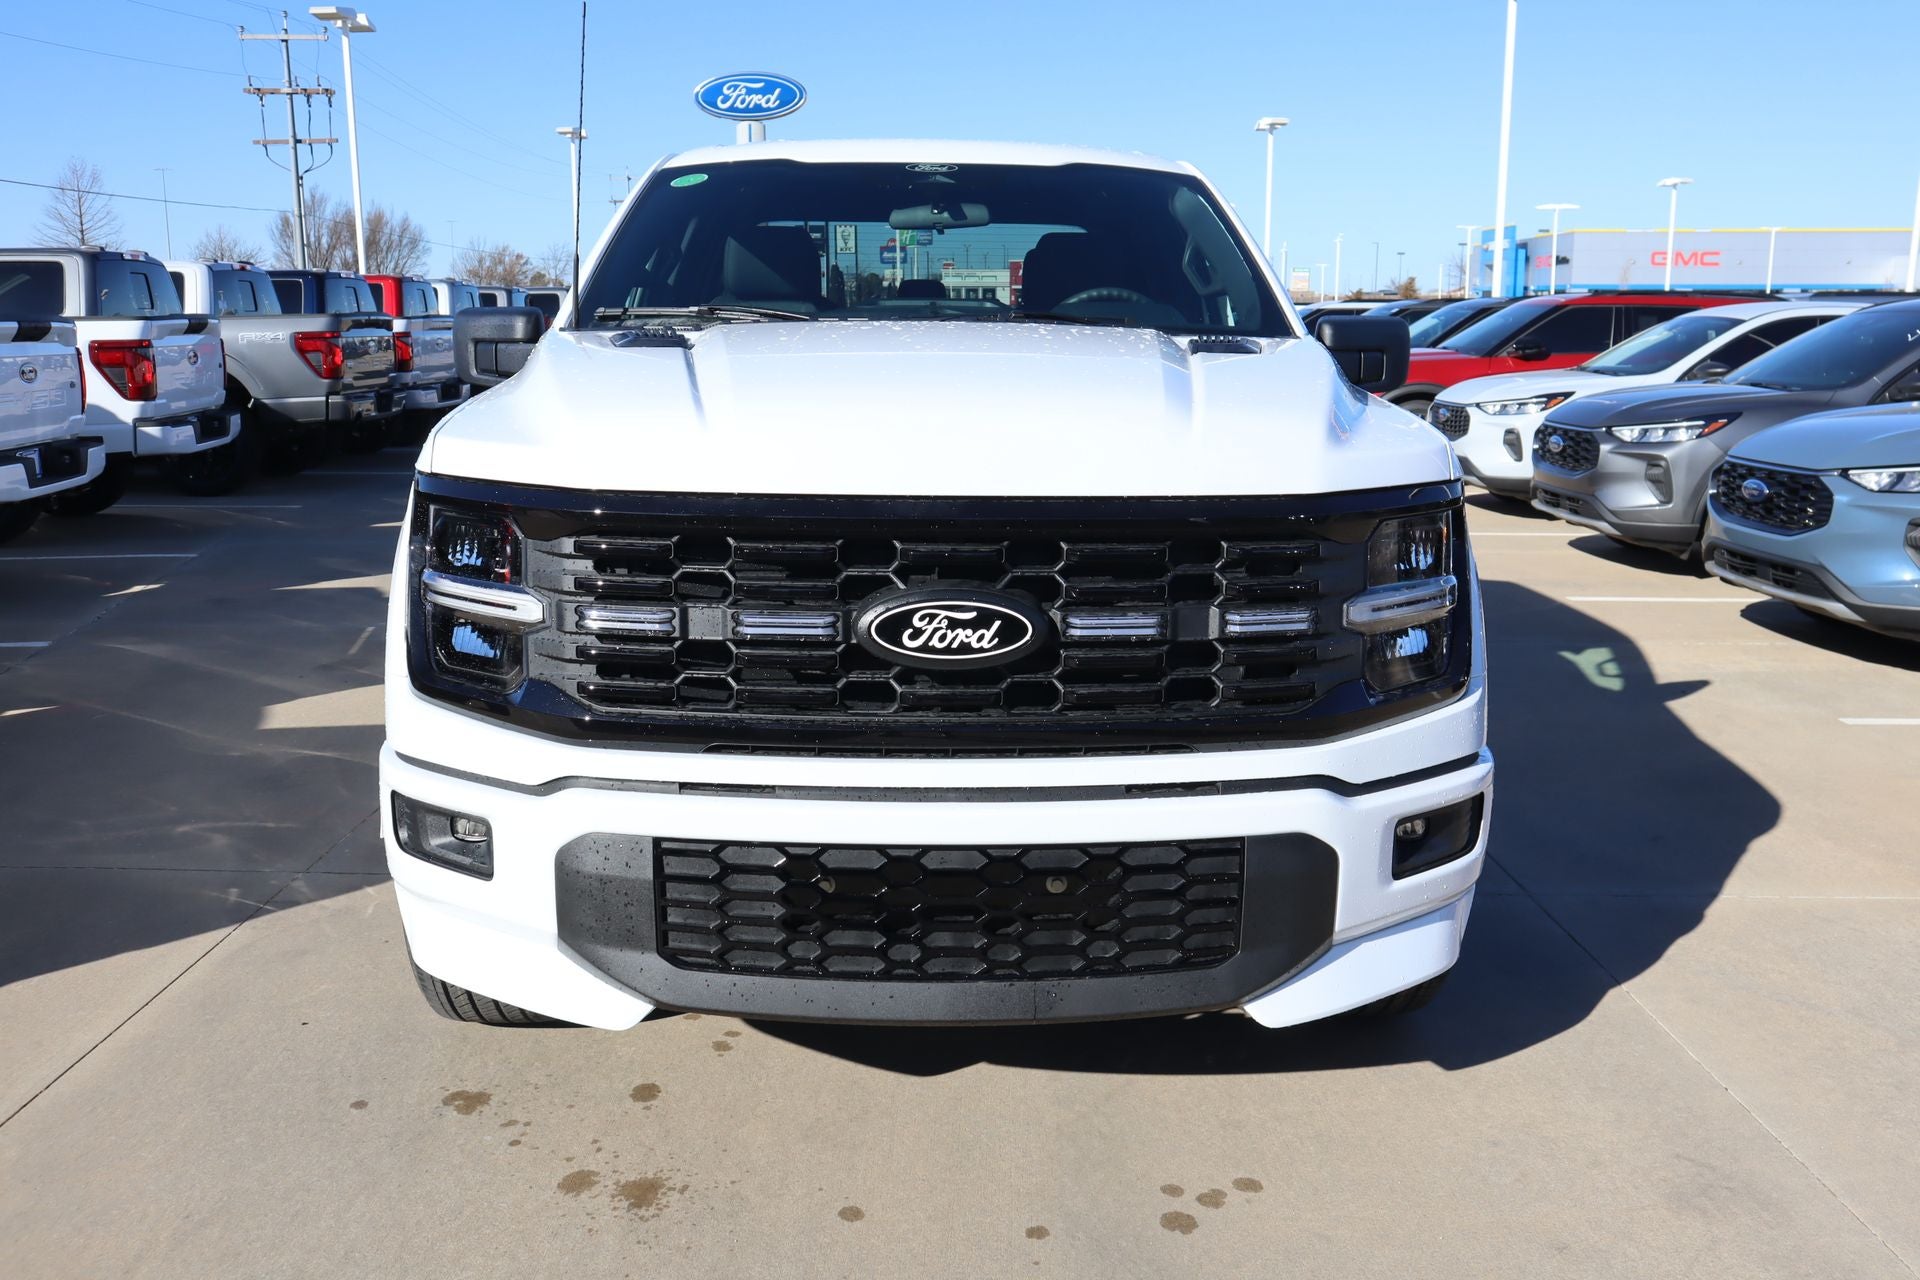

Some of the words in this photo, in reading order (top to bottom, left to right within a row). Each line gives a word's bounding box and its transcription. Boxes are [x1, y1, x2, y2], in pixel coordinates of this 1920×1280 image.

[716, 81, 782, 109] Ford
[1651, 251, 1721, 267] GMC
[238, 332, 287, 344] FX4
[902, 609, 1002, 649] Ford
